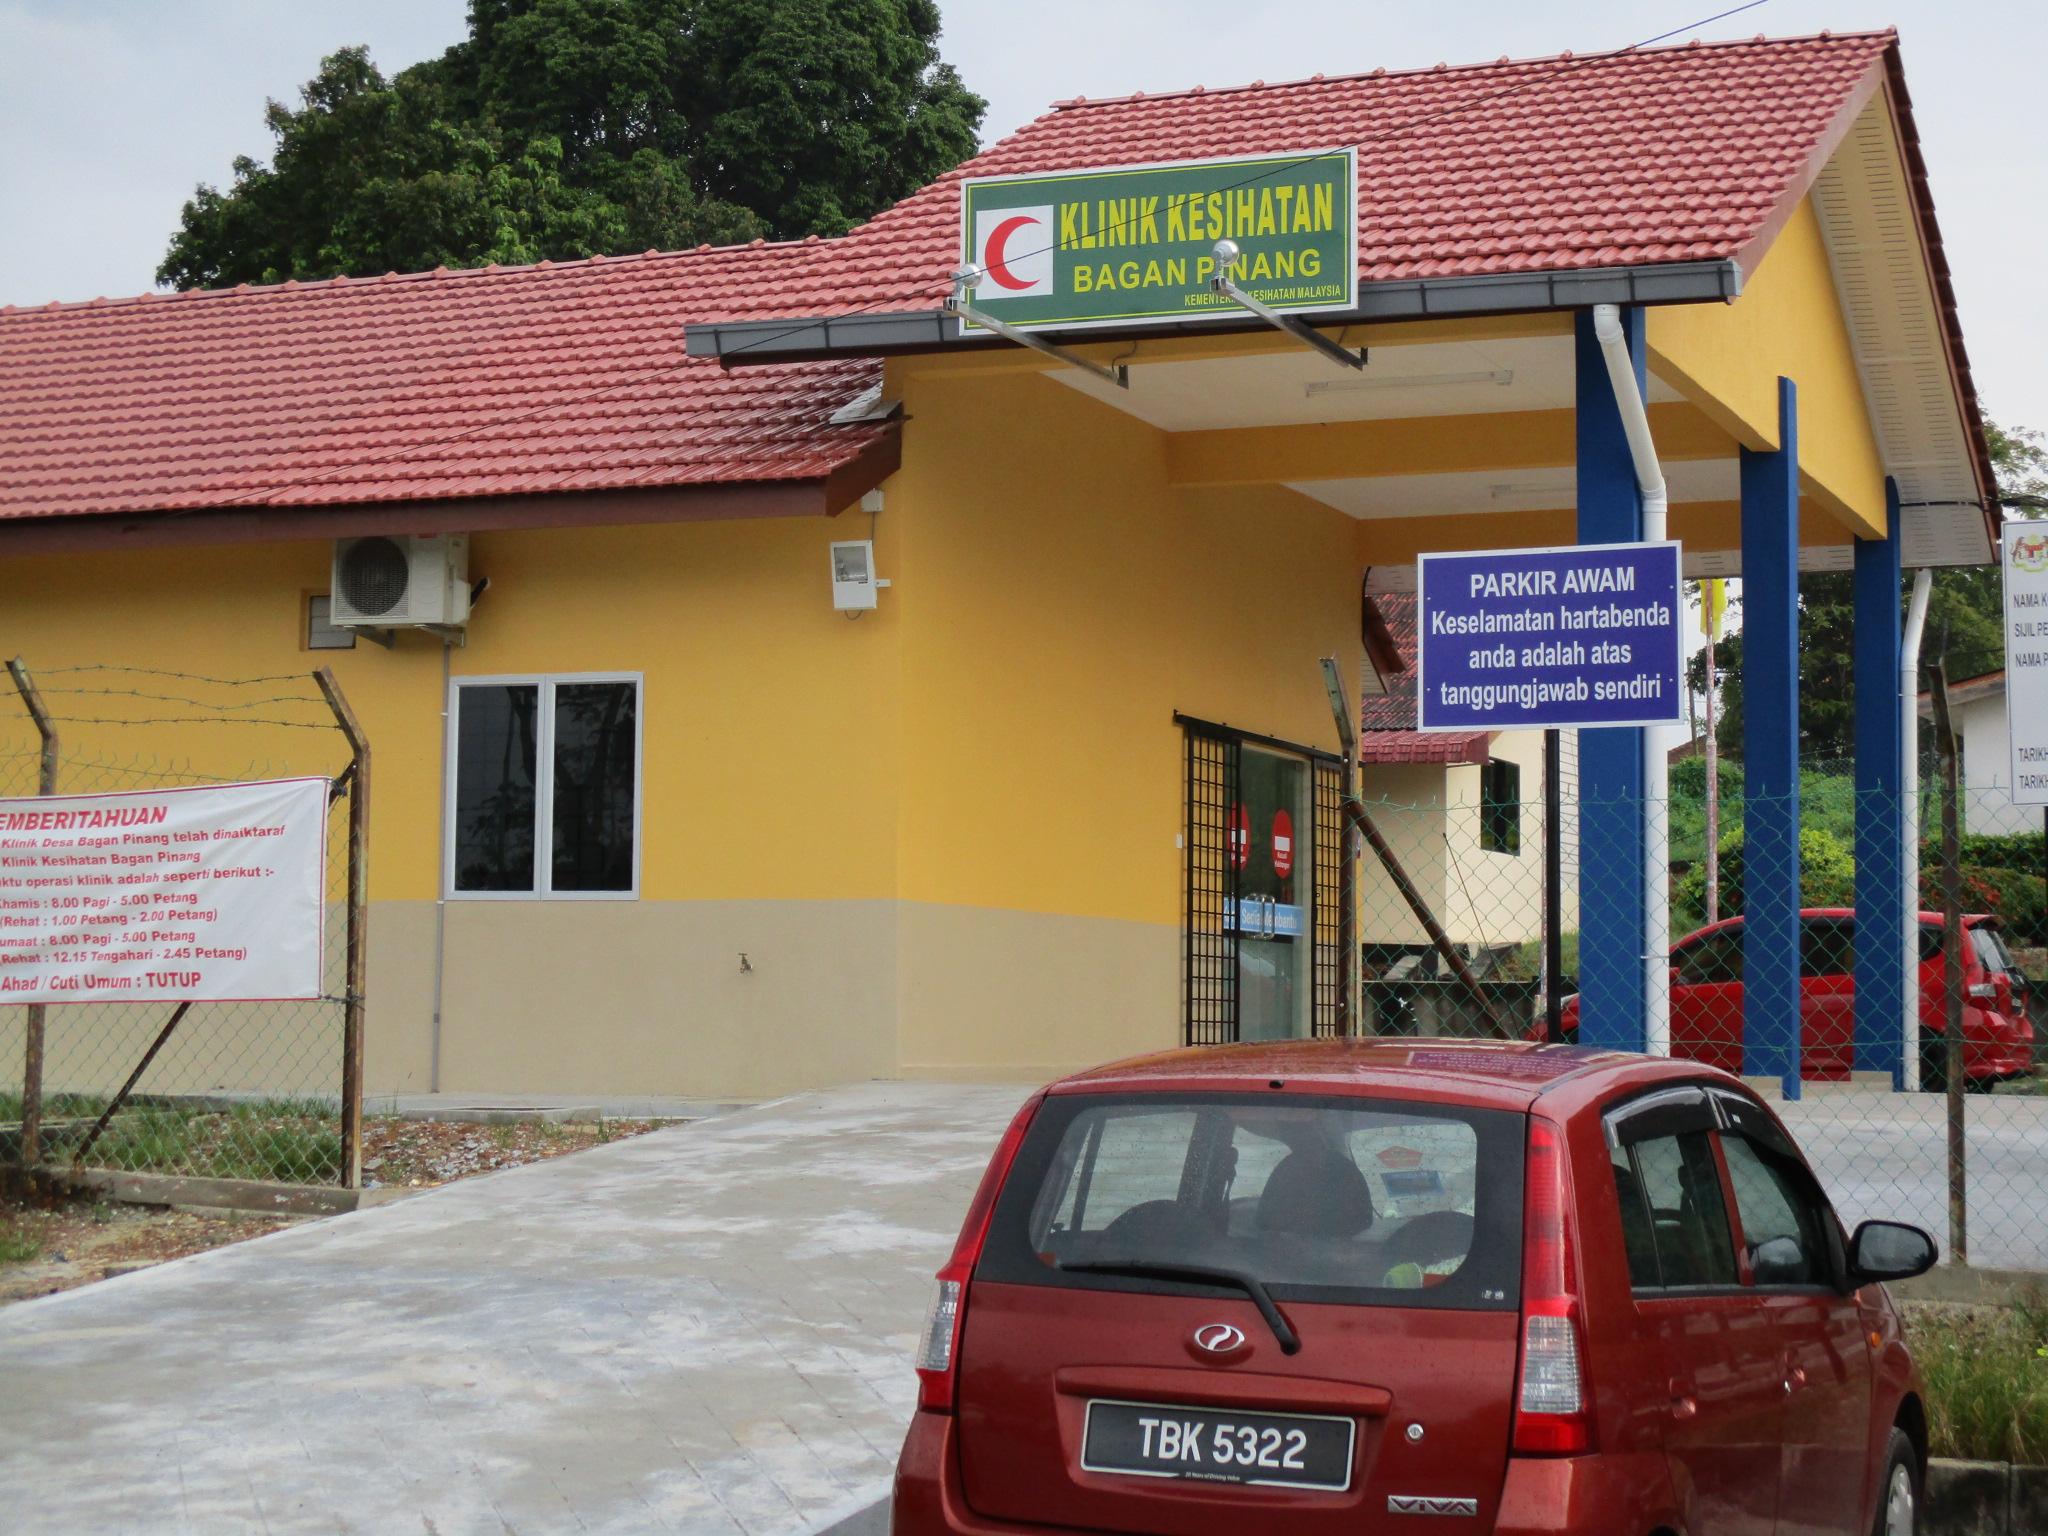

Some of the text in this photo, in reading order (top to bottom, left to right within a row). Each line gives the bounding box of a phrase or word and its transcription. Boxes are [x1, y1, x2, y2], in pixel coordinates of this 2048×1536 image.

[1060, 182, 1333, 251] KLINIK KESIHATAN
[1073, 248, 1321, 293] BAGAN PNANG
[1247, 287, 1296, 302] KESIHATAN
[1297, 284, 1341, 299] MALAYSIA
[1470, 566, 1635, 598] PARKIR AWAM
[2013, 593, 2040, 608] NAMA
[1432, 602, 1670, 635] Keselamatan hartabenda
[2014, 622, 2034, 637] SIJIL
[1469, 640, 1632, 669] anda adalah atas
[2015, 652, 2041, 667] NAMA
[1441, 673, 1661, 711] tanggungjawab sendiri
[0, 806, 168, 831] EMBERITAHUAN
[1, 825, 286, 849] Klinik Desa Bagan Pinang telah dinaiktaraf
[1, 851, 201, 867] Klinik Kesihatan Bagan Pinang
[26, 875, 73, 889] operasi
[77, 874, 113, 886] klinik
[118, 872, 160, 884] adalah
[163, 868, 210, 884] seperti
[213, 866, 261, 879] berikut
[51, 897, 79, 908] 8.00
[83, 896, 110, 909] Pagi
[120, 894, 149, 906] 5.00
[153, 893, 198, 905] Petang
[51, 915, 77, 926] 1.00
[81, 914, 128, 926] Petang
[140, 911, 164, 922] 2.00
[168, 908, 218, 922] Petang)
[49, 934, 79, 946] 8.00
[83, 933, 112, 947] Pagi
[121, 931, 148, 943] 5.00
[151, 930, 197, 943] Petang
[53, 950, 88, 963] 12.15
[91, 948, 153, 963] Tengahari
[163, 947, 191, 960] 2.45
[195, 946, 248, 961] Petang)
[1, 975, 39, 991] Ahad
[49, 974, 80, 990] Cuti
[84, 973, 132, 989] Umum
[145, 971, 202, 988] TUTUP
[1139, 1418, 1307, 1469] TBK 5322
